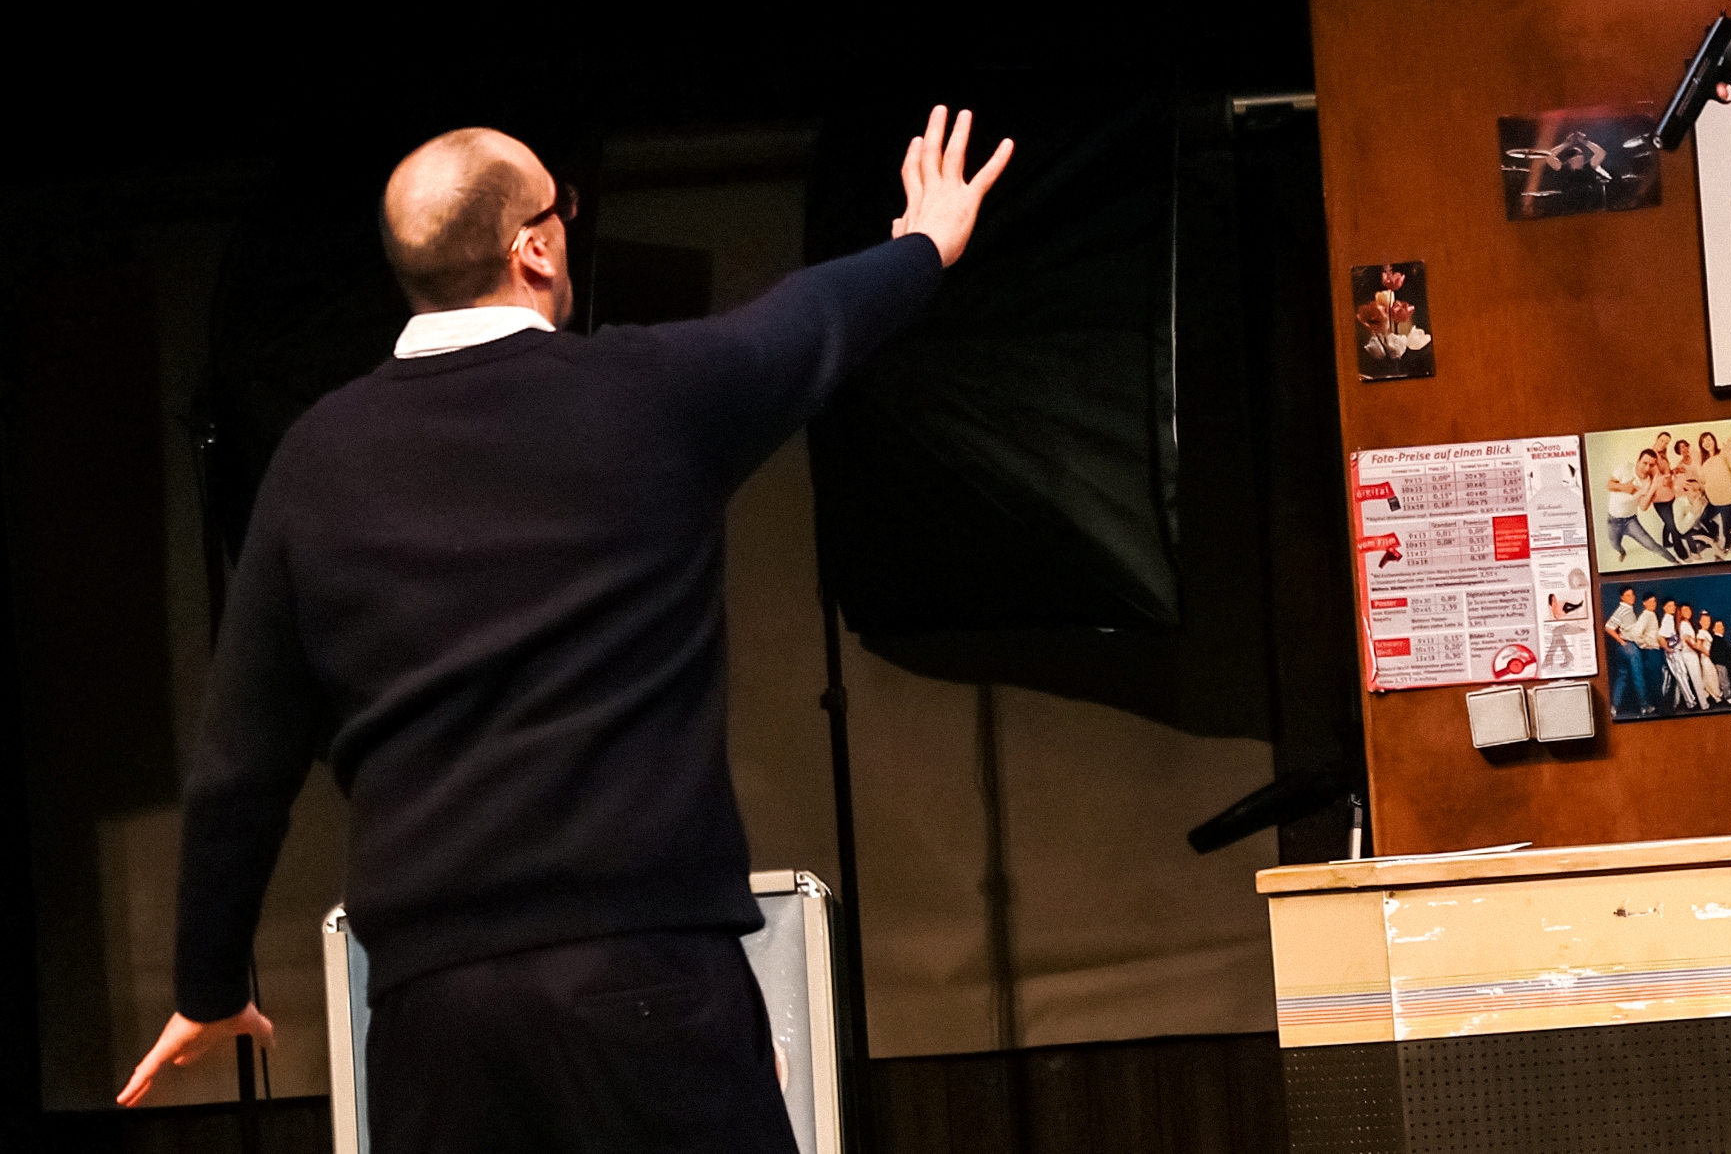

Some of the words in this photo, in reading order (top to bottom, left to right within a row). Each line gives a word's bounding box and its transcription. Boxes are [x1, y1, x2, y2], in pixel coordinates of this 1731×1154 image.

[1372, 452, 1430, 464] Foto-Preise
[1434, 450, 1452, 462] auf
[1453, 447, 1482, 458] einen
[1485, 445, 1512, 456] Blick
[1356, 487, 1389, 499] digital
